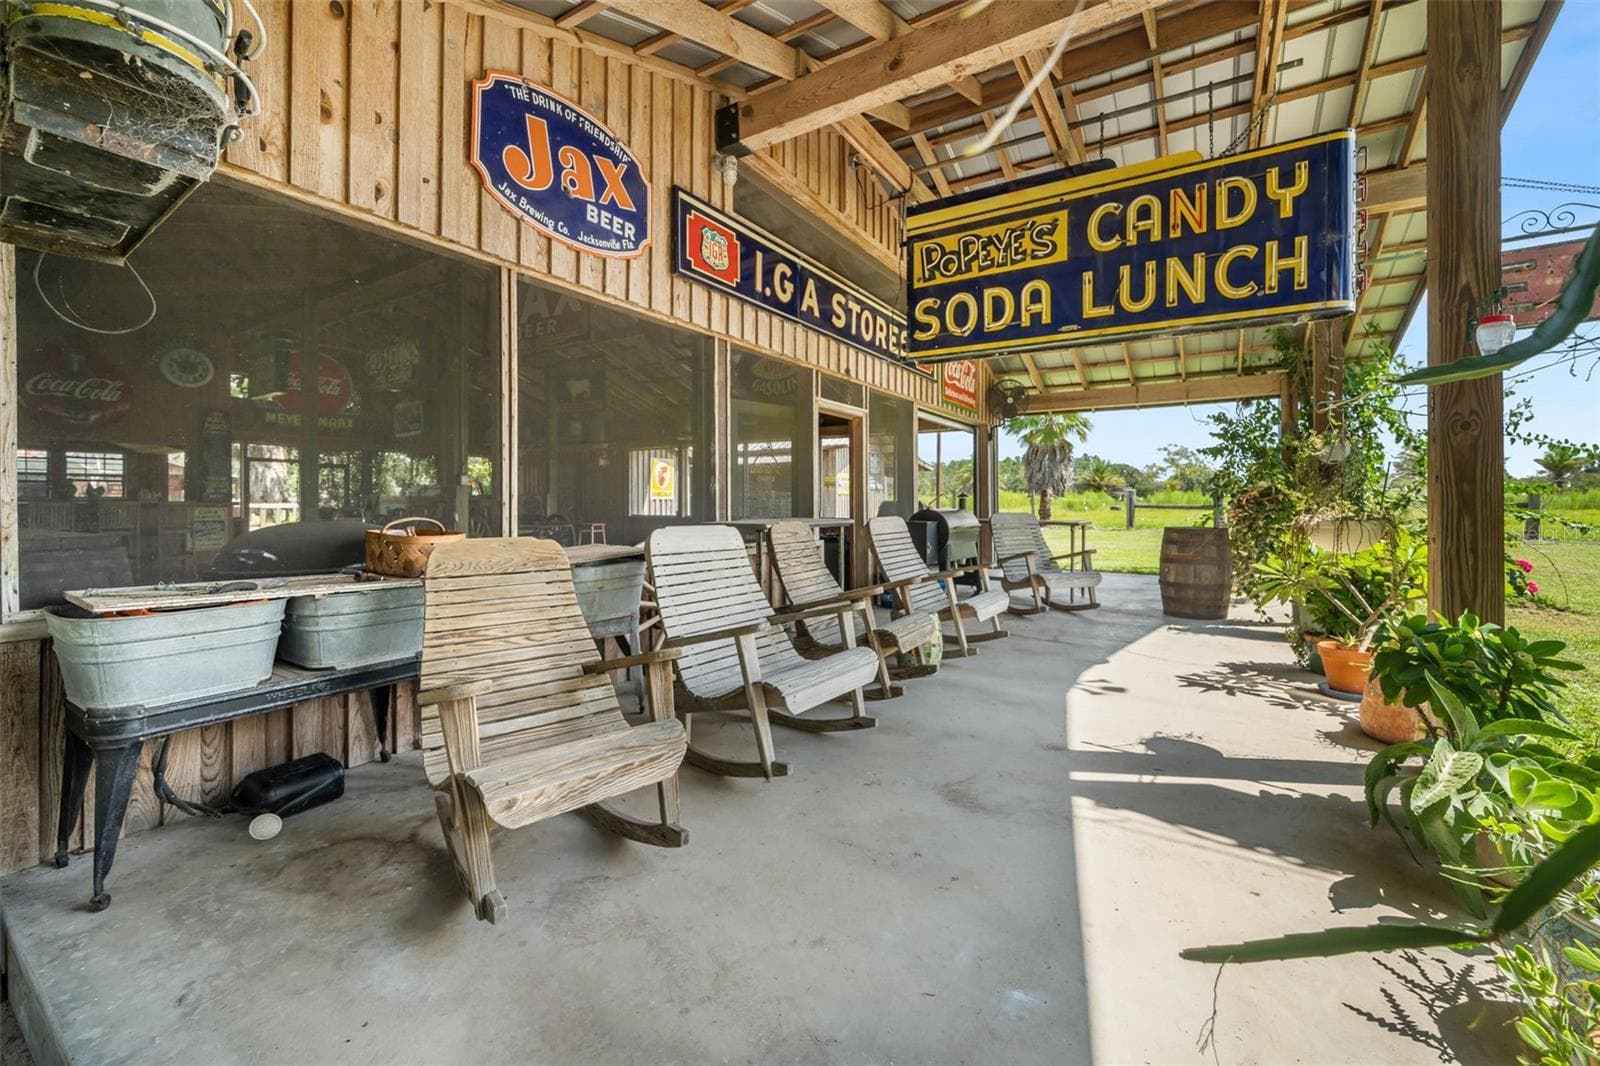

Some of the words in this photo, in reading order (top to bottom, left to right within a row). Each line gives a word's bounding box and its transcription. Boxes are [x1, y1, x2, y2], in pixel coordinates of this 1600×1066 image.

[532, 93, 563, 115] DRINK
[564, 109, 577, 123] OF
[502, 113, 637, 212] Jax
[498, 182, 517, 202] Jax
[519, 196, 555, 231] Brewing
[557, 221, 570, 236] Co.
[586, 203, 636, 241] BEER
[1087, 160, 1309, 252] CANDY
[1082, 235, 1309, 319] LUNCH
[519, 319, 557, 339] EER
[831, 293, 907, 357] STORES
[913, 279, 1052, 342] SODA
[25, 372, 126, 402] Coca-Cola
[265, 411, 302, 425] MEYE
